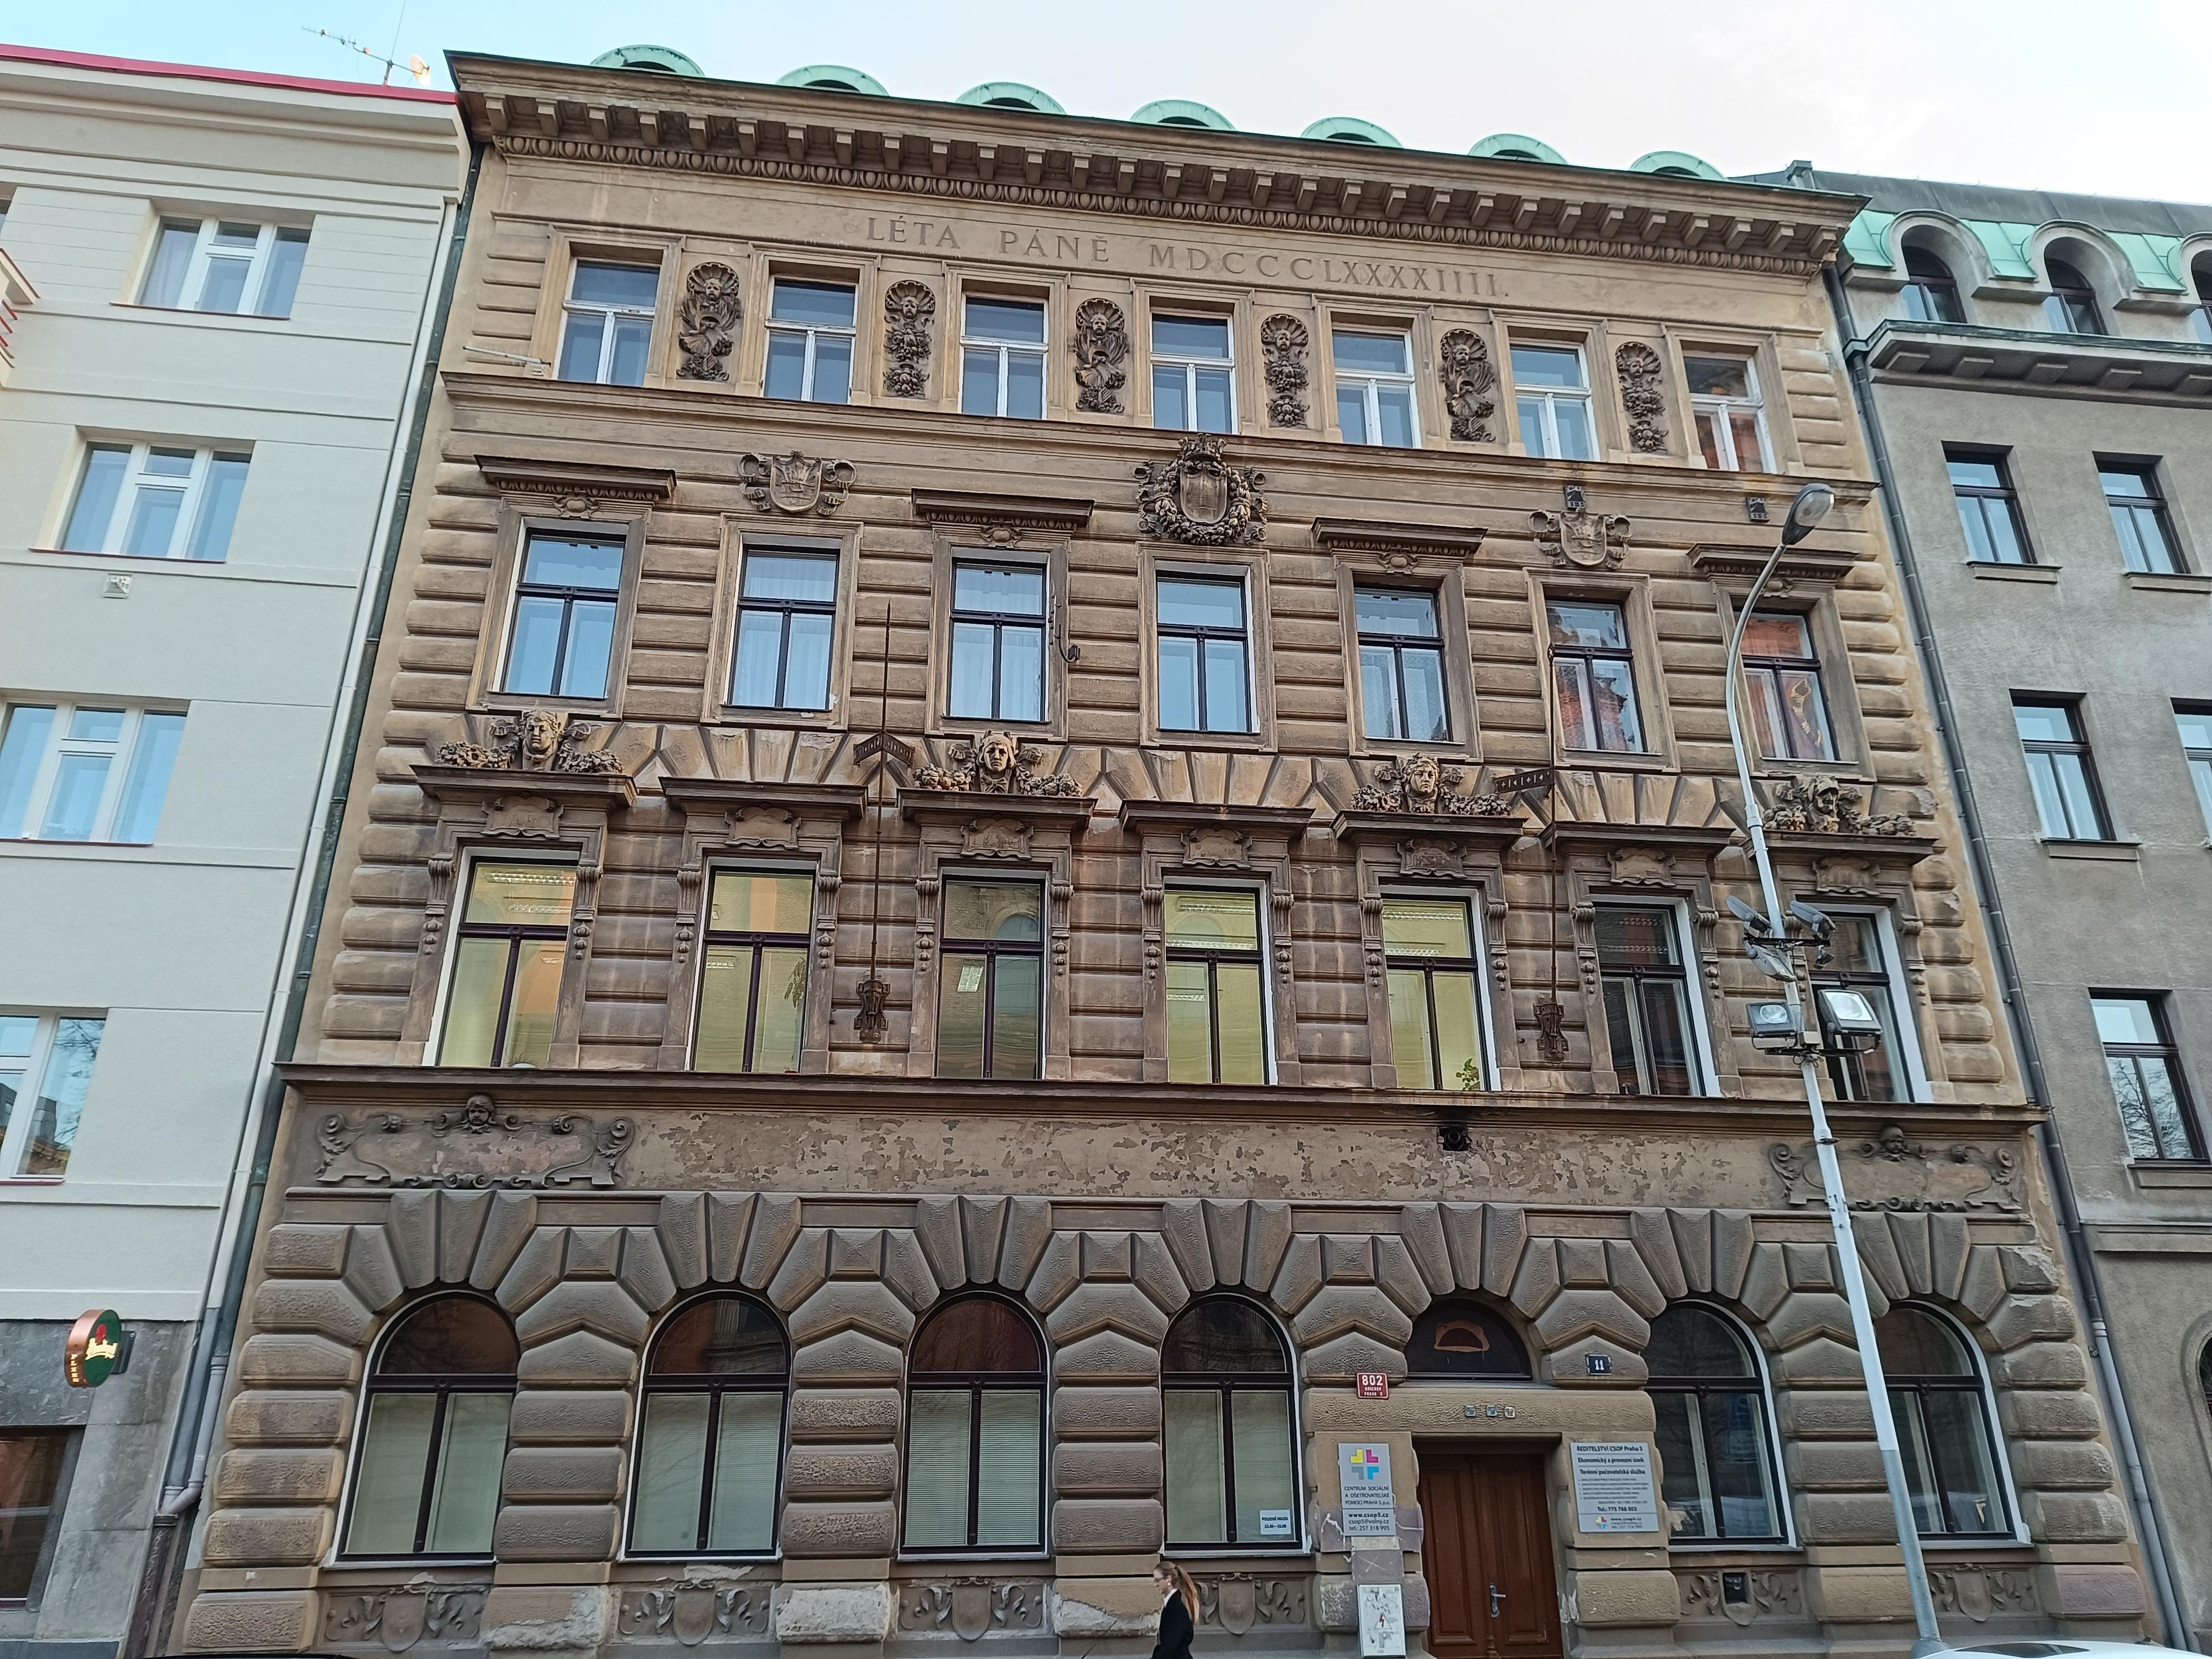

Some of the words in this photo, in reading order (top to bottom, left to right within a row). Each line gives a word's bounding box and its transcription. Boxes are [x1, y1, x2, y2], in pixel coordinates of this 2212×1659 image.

[867, 216, 961, 249] LÉTA
[998, 228, 1109, 262] PÁNĚ
[1595, 1359, 1605, 1370] 11
[1361, 1375, 1383, 1386] 802
